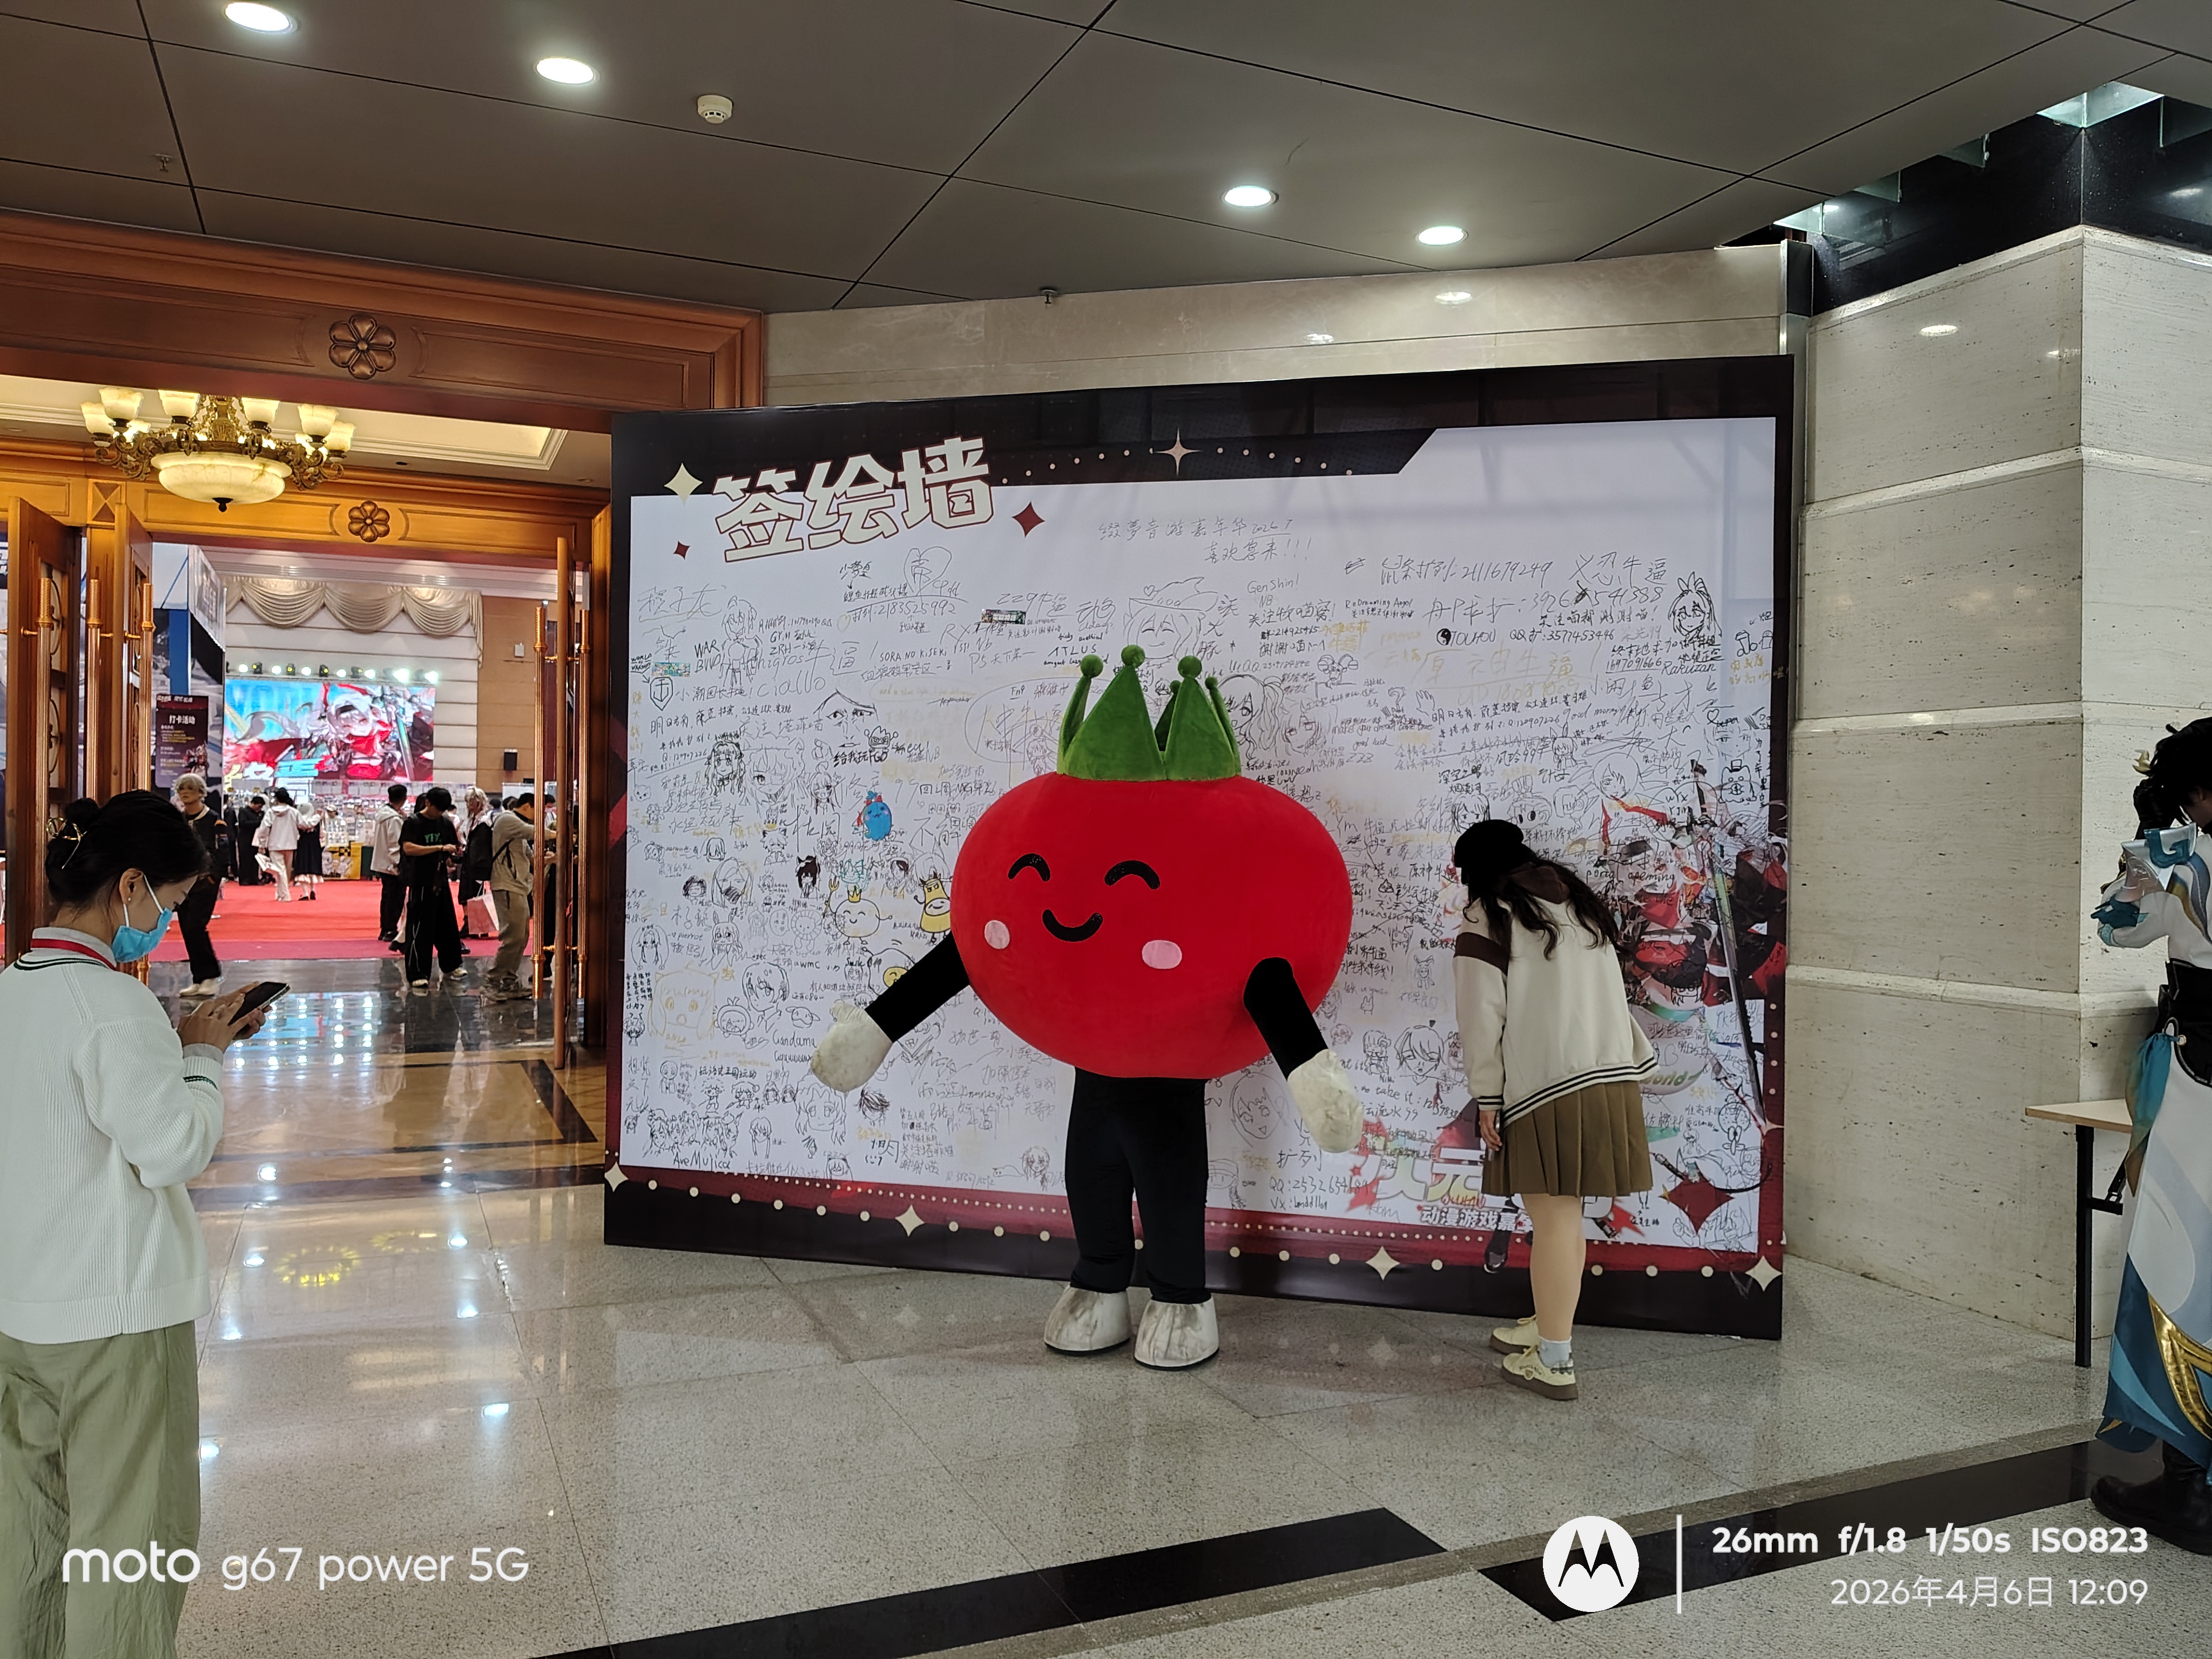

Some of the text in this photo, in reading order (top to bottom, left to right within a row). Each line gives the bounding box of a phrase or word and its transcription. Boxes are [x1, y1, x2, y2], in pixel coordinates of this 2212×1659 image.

[712, 436, 994, 563] 签绘墙
[833, 750, 888, 767] 给我玩FGO
